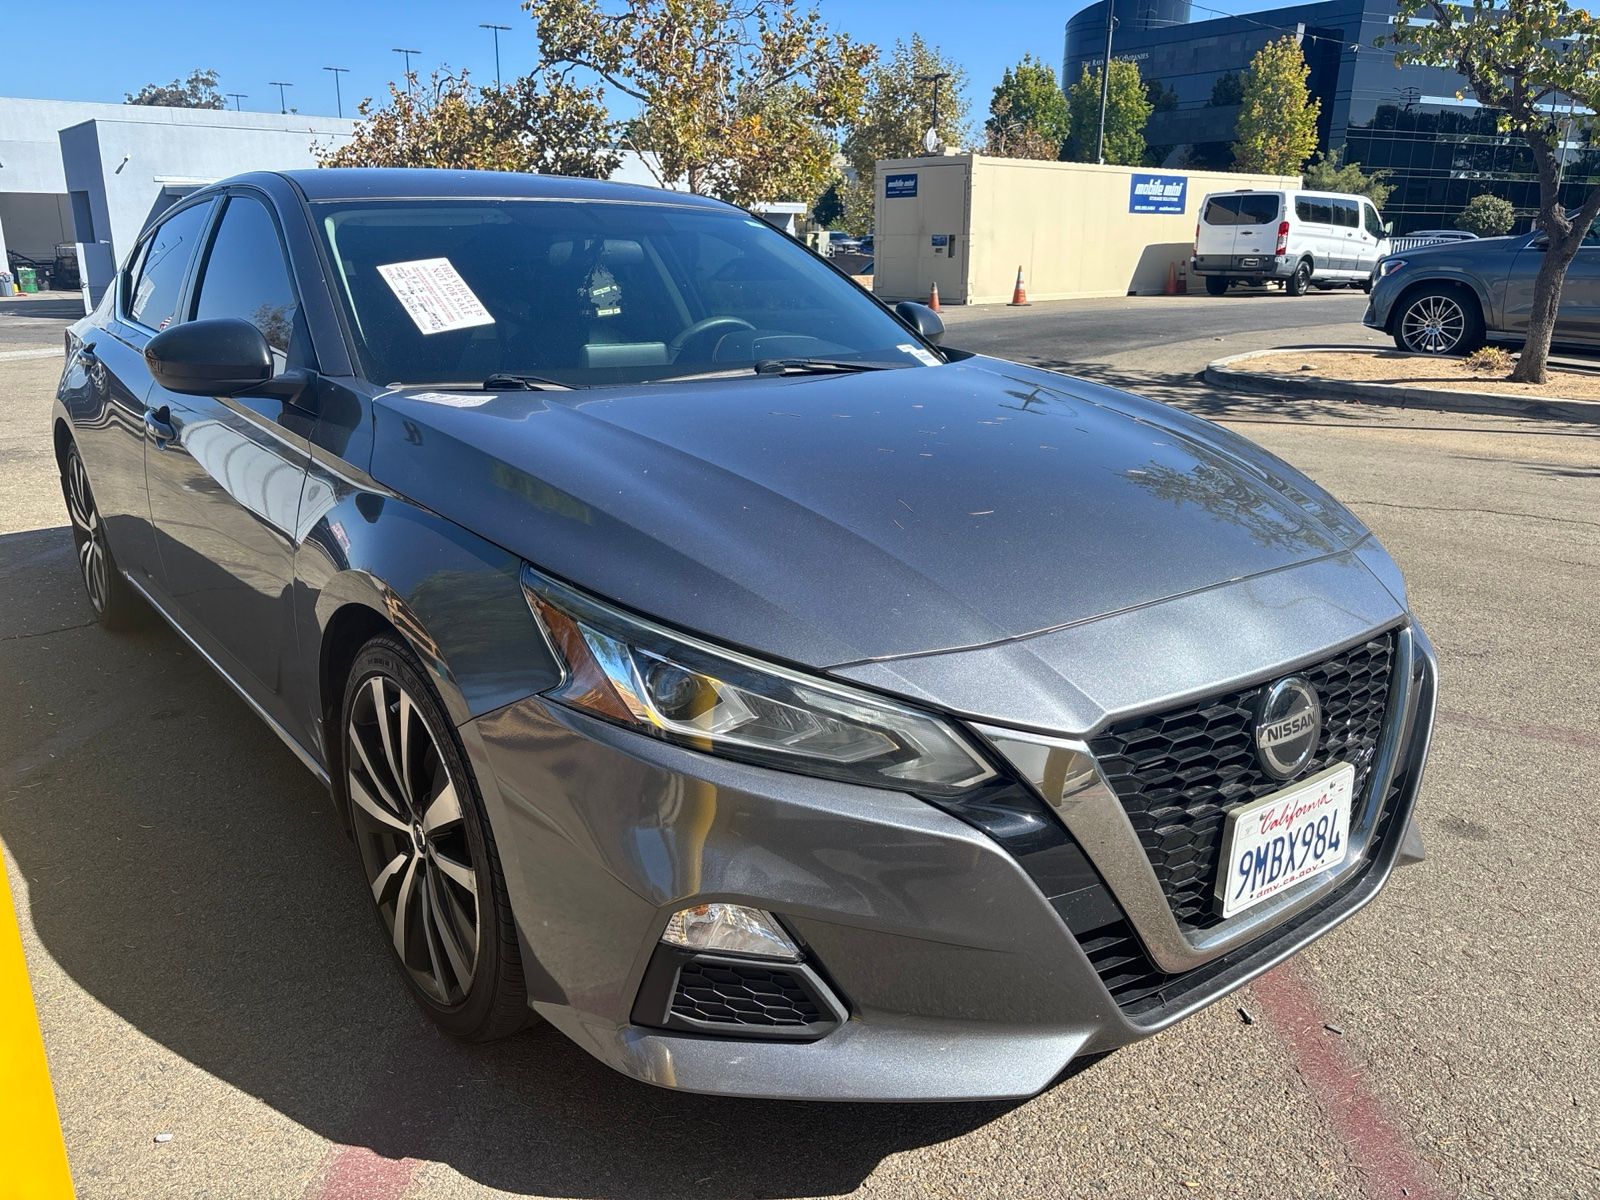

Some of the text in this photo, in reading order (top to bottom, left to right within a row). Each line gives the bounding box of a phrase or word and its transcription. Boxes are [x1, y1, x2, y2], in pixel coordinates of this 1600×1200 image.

[1135, 179, 1183, 196] mobile mini
[432, 267, 473, 315] NOT FOR SALE
[439, 263, 486, 317] THIS VEHICLE IS
[1266, 712, 1315, 742] NISSAN
[1260, 792, 1333, 835] California
[1235, 809, 1340, 900] 9MBX984
[1256, 865, 1319, 899] dmv.ca.gov
